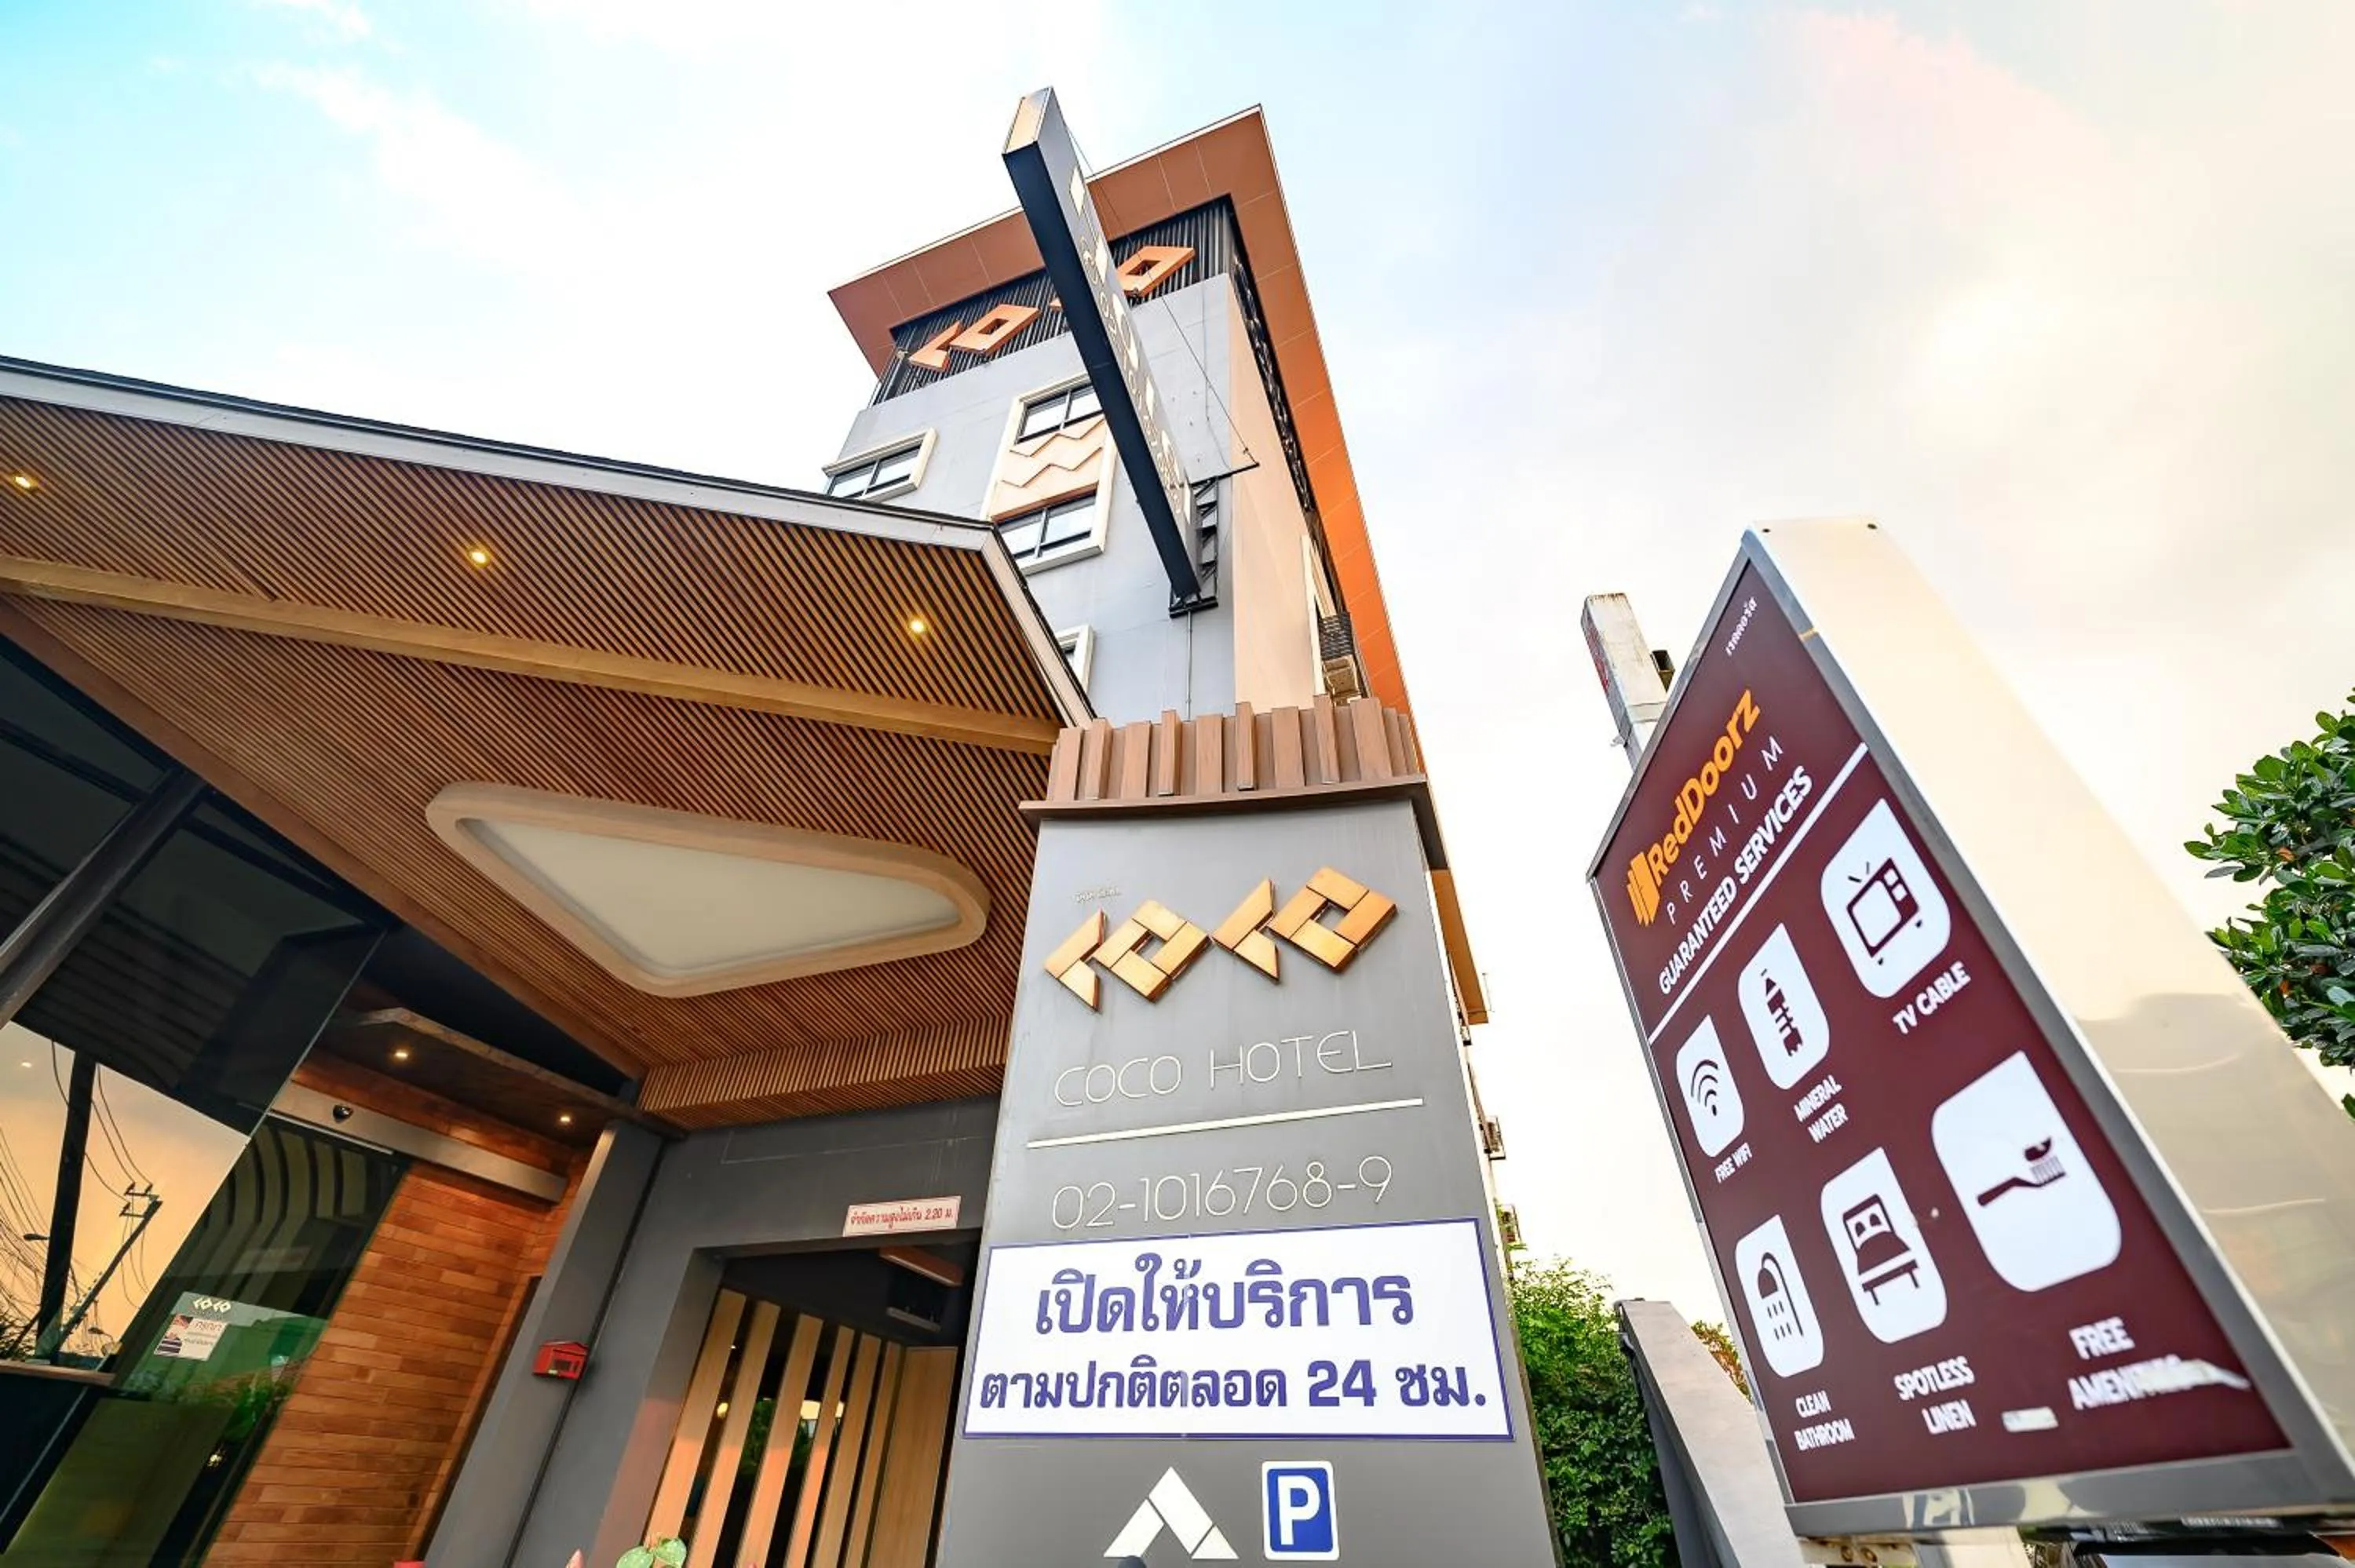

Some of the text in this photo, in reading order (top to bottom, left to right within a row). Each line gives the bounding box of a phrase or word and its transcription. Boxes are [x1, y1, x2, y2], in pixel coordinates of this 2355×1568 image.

[1648, 689, 1760, 885] RedDoorz
[1666, 735, 1784, 925] PREMIUM
[1659, 765, 1814, 994] GUARANTEED SERVICES
[1893, 961, 1971, 1034] TV CABLE
[1054, 1030, 1393, 1107] COCO HOTEL
[1793, 1074, 1842, 1122] MINERAL
[1808, 1103, 1849, 1143] WATER
[1052, 1155, 1393, 1229] 02-1016768-9
[1714, 1157, 1736, 1183] FREE
[1035, 1252, 1414, 1334] เปิดให้บริการ
[2068, 1316, 2135, 1360] FREE
[980, 1354, 1486, 1409] ตามปกติตลอด 24 ชม.
[1795, 1390, 1832, 1418] CLEAN
[1893, 1355, 1976, 1401] SPOTLESS
[1794, 1418, 1856, 1451] BATHROOM
[1921, 1398, 1977, 1435] LINEN
[1277, 1475, 1321, 1545] P
